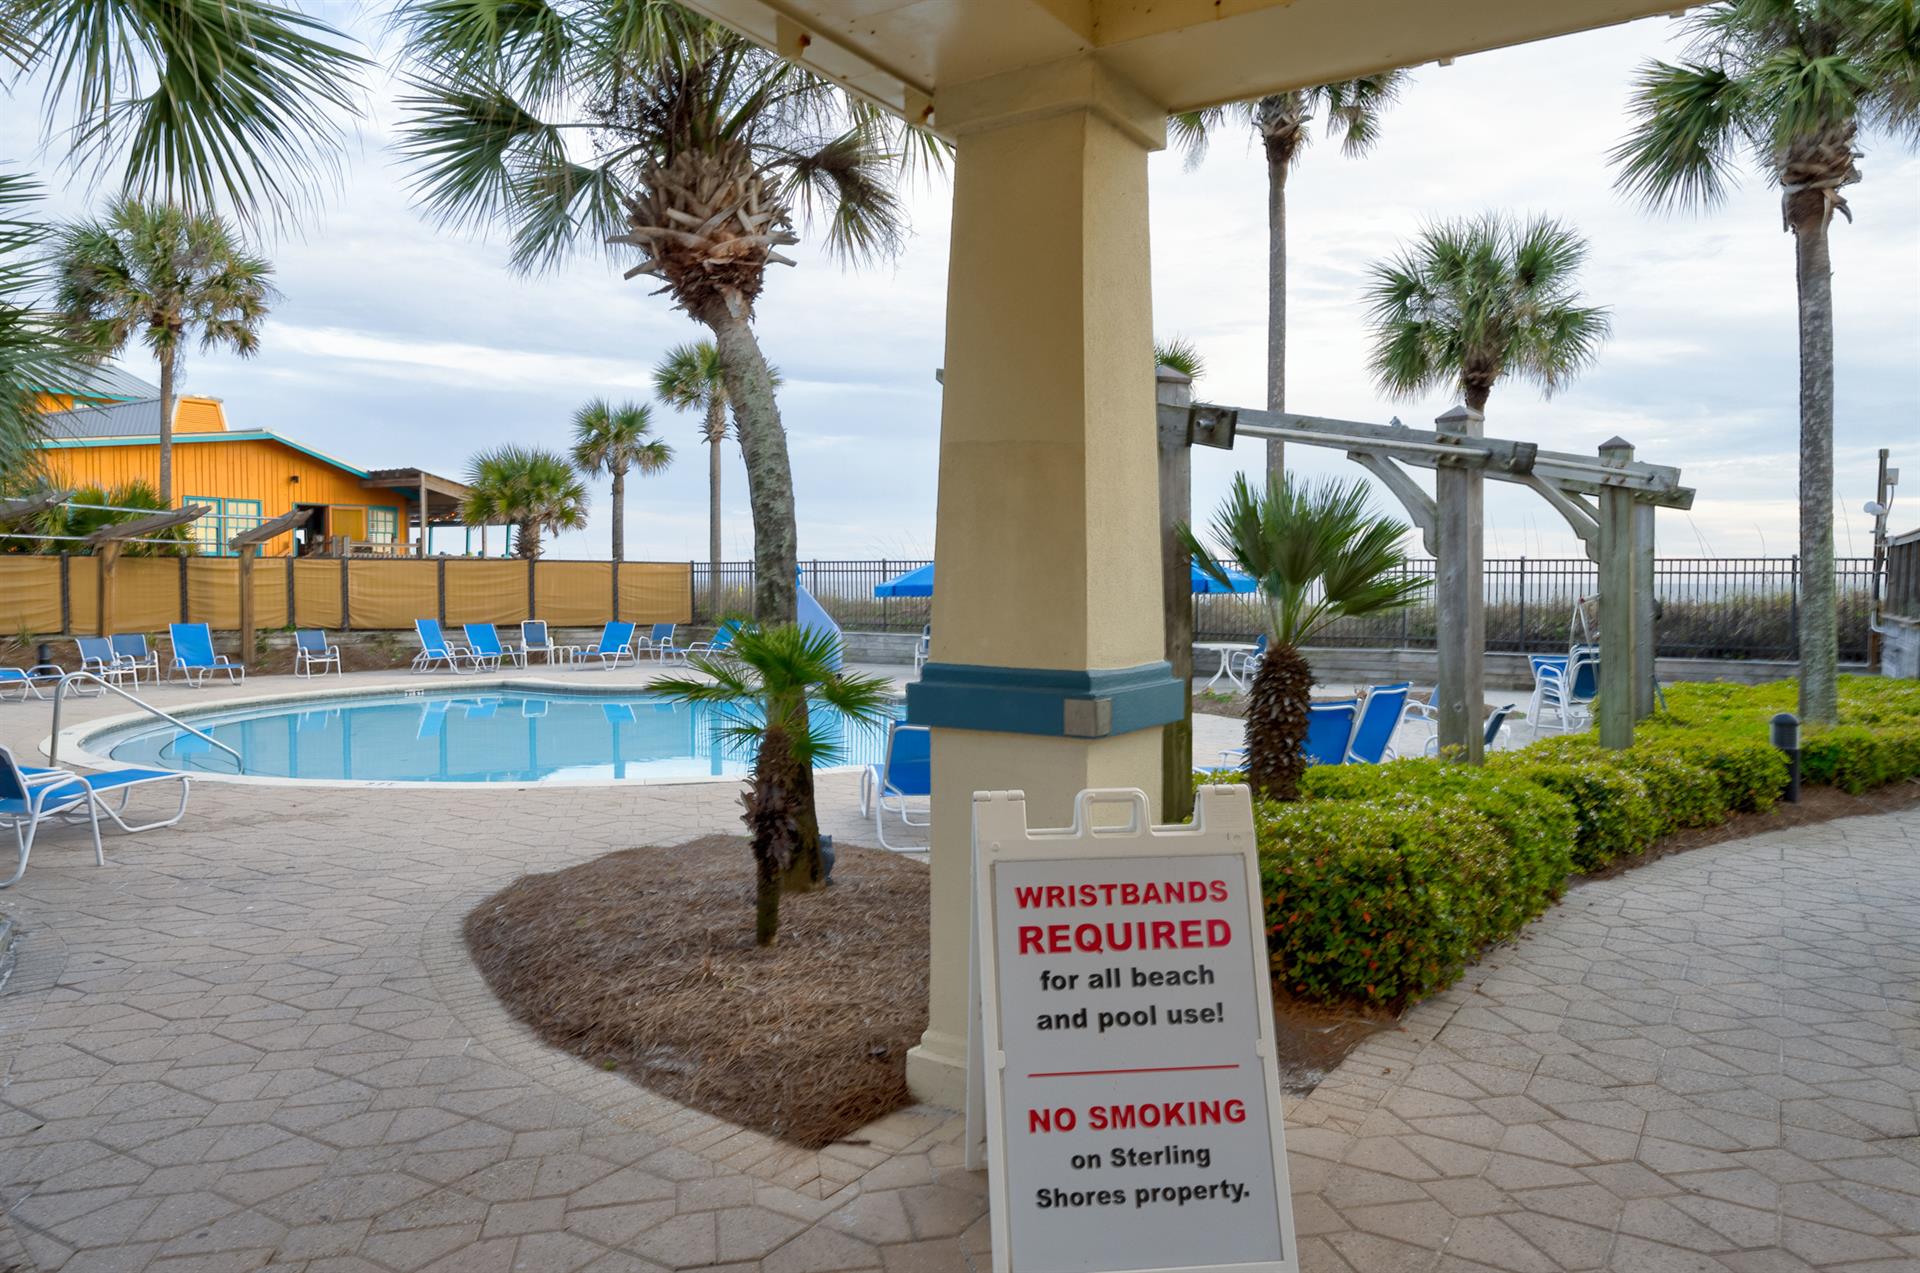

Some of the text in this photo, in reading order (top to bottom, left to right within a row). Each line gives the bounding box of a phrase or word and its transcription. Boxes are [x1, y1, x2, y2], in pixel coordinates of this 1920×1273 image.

[1014, 880, 1229, 909] WRISTBANDS
[1018, 918, 1232, 955] REQUIRED
[1040, 965, 1214, 991] for all beach
[1037, 1002, 1223, 1033] and pool use!
[1028, 1099, 1247, 1134] NO SMOKING
[1071, 1145, 1210, 1169] on Sterling
[1037, 1180, 1249, 1208] Shores property.
